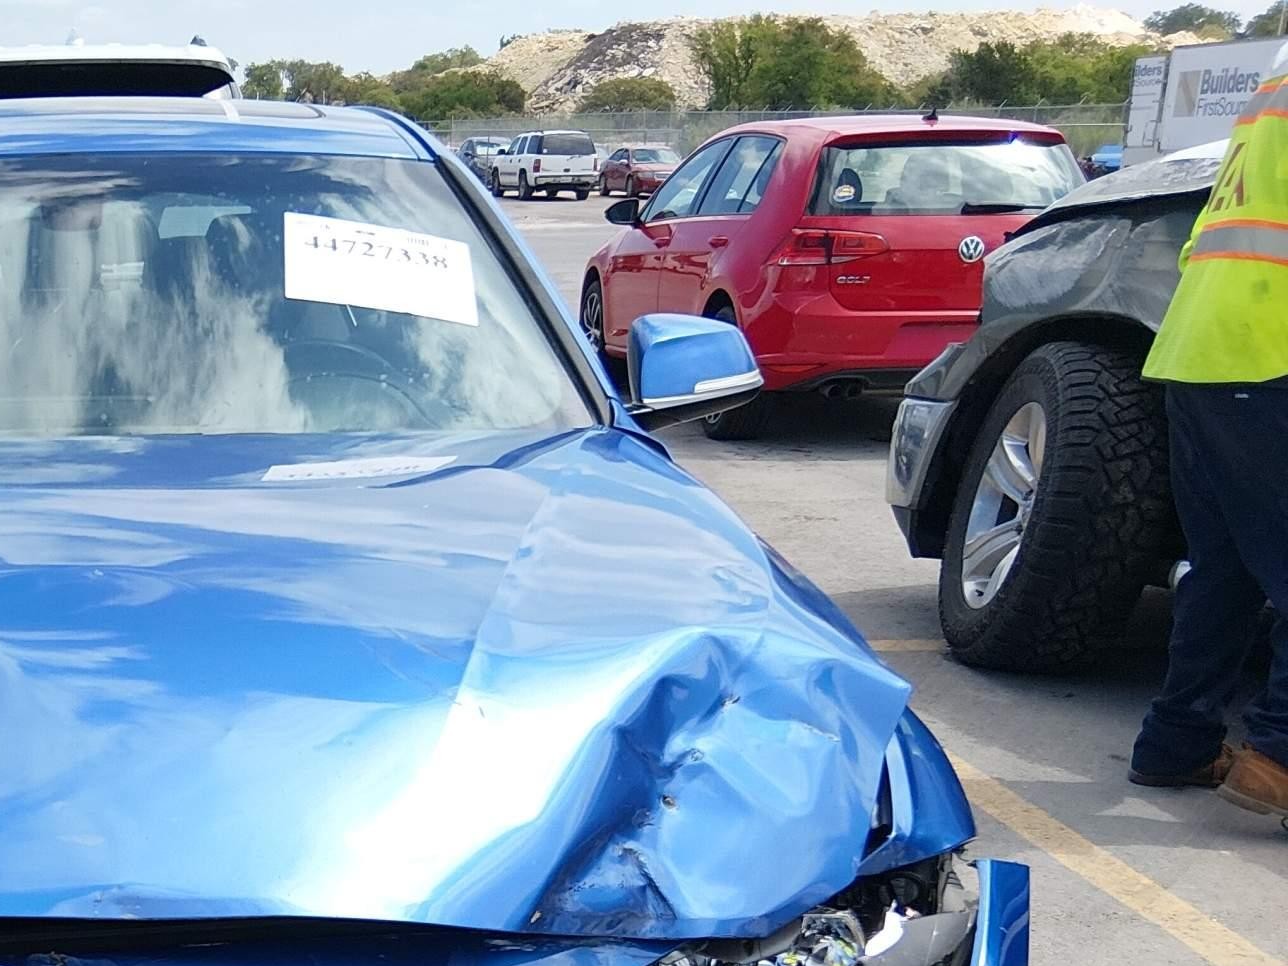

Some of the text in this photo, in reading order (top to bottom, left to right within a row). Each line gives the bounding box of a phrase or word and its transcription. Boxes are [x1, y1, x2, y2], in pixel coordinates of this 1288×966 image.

[1200, 67, 1260, 95] Builders
[304, 235, 448, 269] 44727338
[836, 276, 871, 284] GOLF
